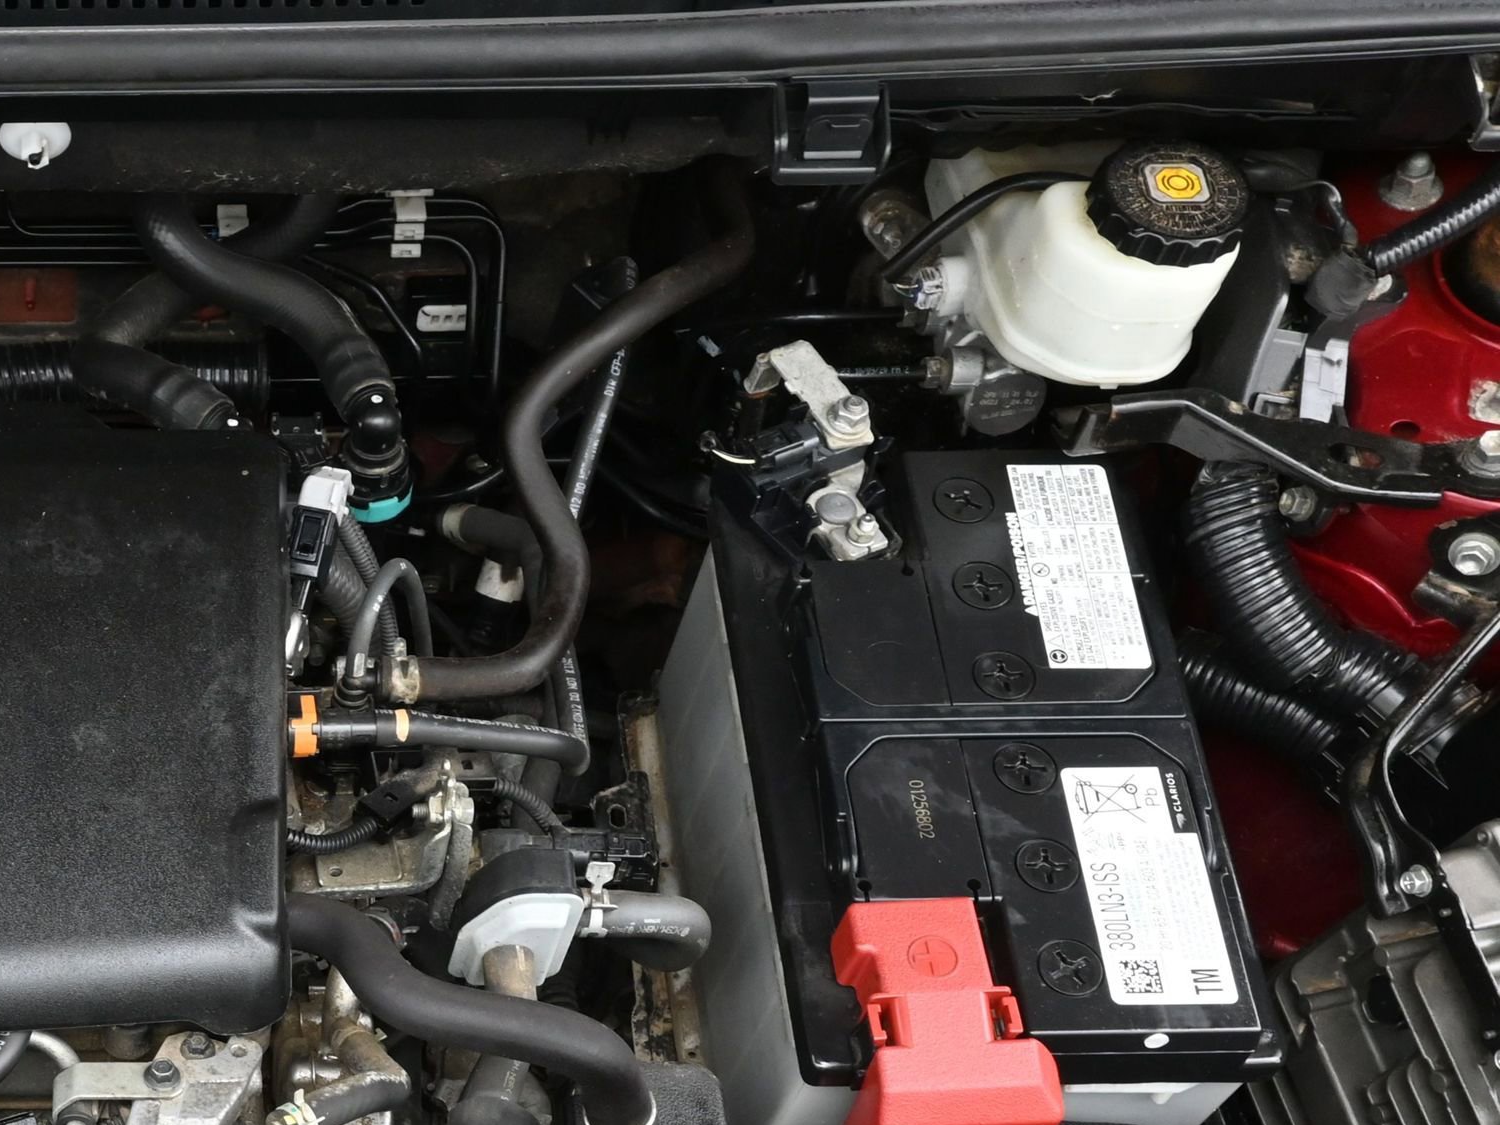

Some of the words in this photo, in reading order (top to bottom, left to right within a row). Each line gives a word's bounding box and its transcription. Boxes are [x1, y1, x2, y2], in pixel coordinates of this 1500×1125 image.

[1004, 511, 1036, 604] DANGER/POISON
[907, 779, 936, 839] 01256802
[1144, 787, 1161, 807] Pb
[1164, 772, 1183, 812] CLARIOS
[1090, 862, 1137, 951] 380LN3-ISS
[1191, 968, 1224, 995] TM
